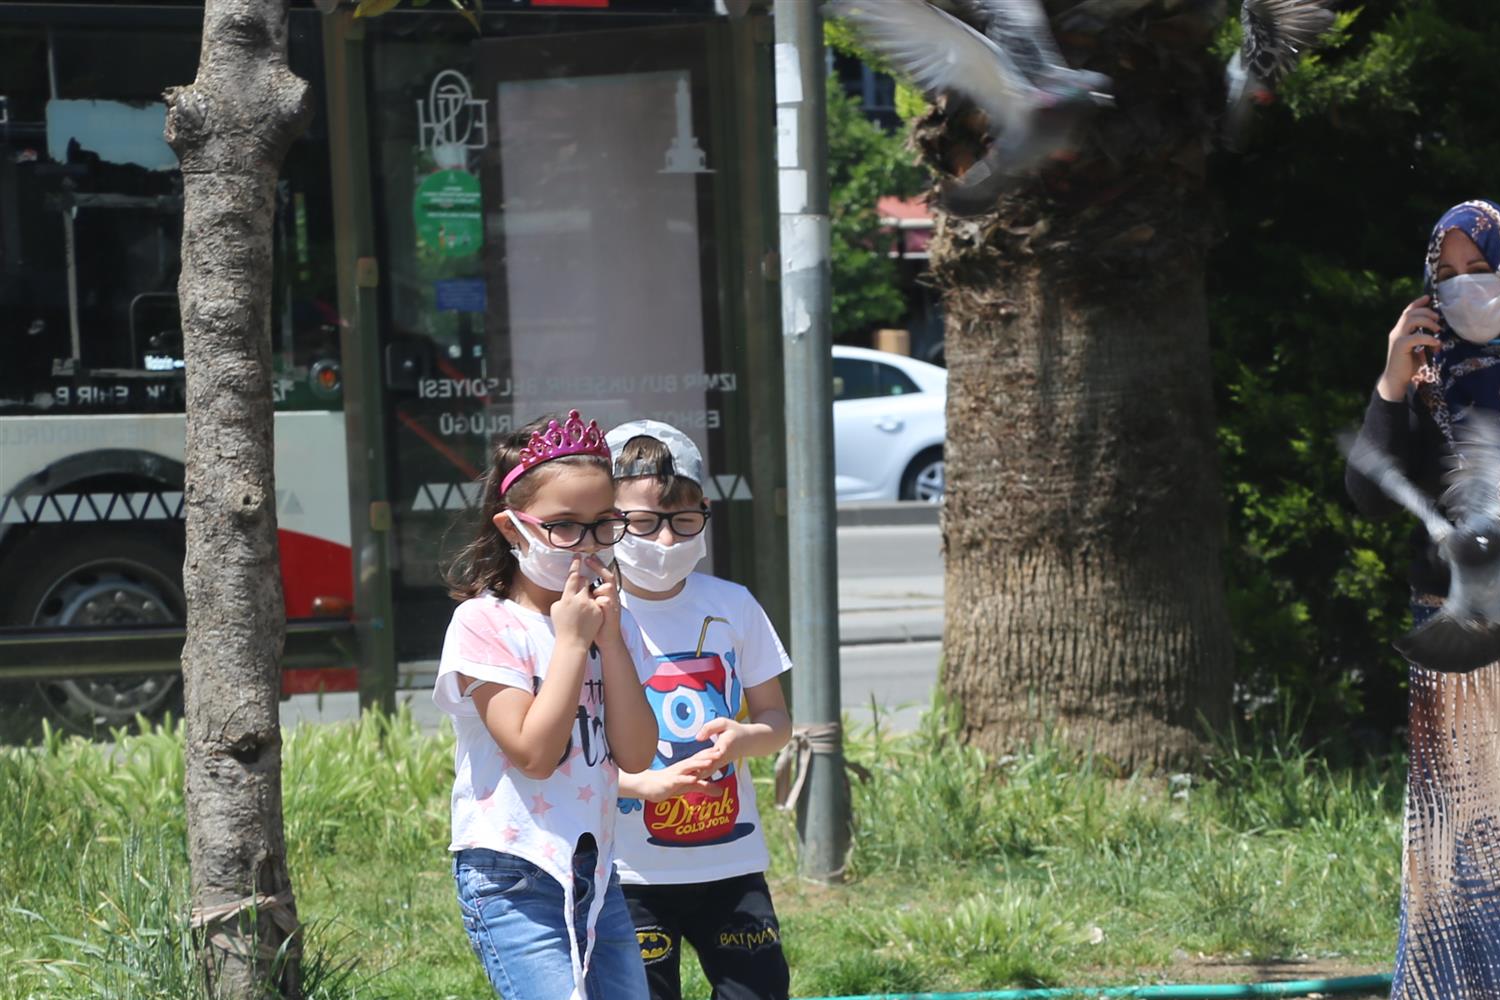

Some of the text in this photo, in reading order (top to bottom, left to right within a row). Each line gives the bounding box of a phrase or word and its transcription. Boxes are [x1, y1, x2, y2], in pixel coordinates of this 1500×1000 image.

[651, 787, 735, 829] Drink
[675, 816, 730, 836] COLD SODA
[719, 927, 779, 950] BATMAN
